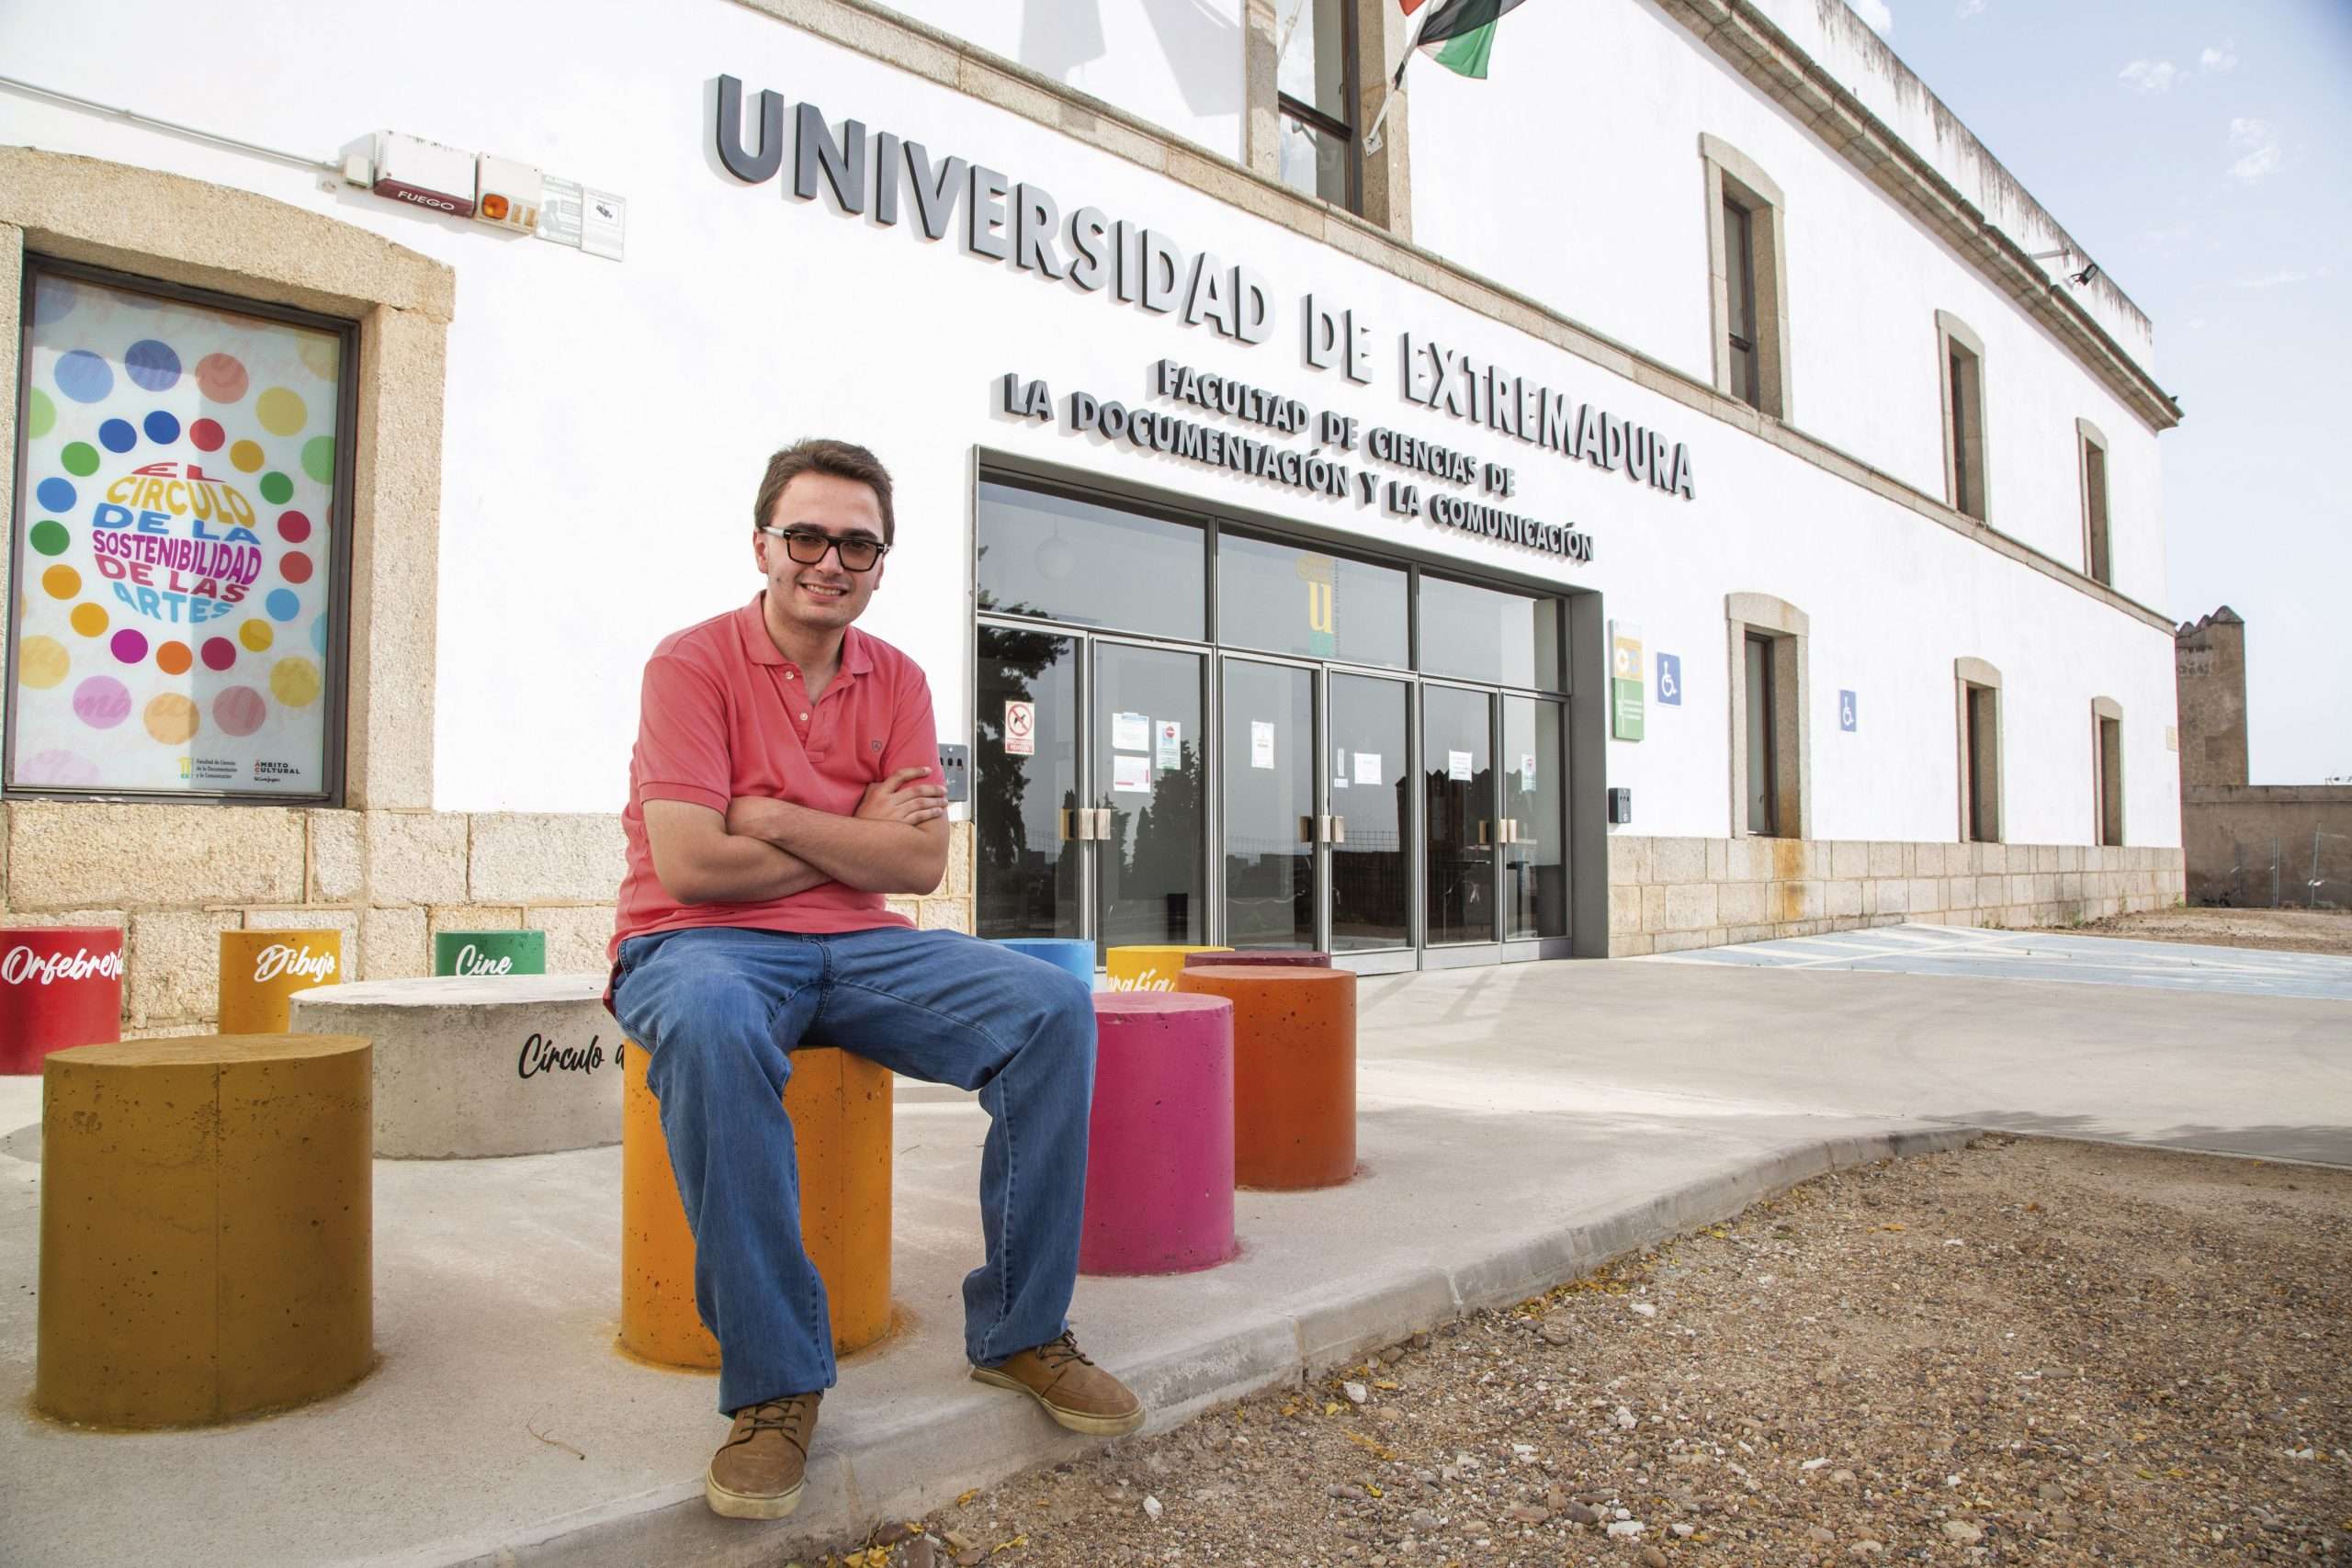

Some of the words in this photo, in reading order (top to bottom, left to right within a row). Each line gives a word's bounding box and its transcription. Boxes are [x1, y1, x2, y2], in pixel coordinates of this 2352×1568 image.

[398, 189, 456, 211] FUEGO
[717, 73, 1275, 345] UNIVERSIDAD
[1306, 293, 1374, 384] DE
[1403, 331, 1696, 500] EXTREMADURA
[1158, 358, 1311, 434] FACULTAD
[1321, 410, 1359, 450] DE
[1369, 426, 1478, 485] CIENCIAS
[1485, 462, 1516, 497] DE
[131, 462, 226, 483] EL
[1003, 372, 1055, 421] LA
[1071, 390, 1351, 497] DOCUMENTACIÓN
[1359, 470, 1380, 504] Y
[1388, 480, 1422, 517] LA
[1430, 492, 1594, 561] COMUNICACIÓN
[92, 502, 171, 535] DE
[192, 519, 262, 546] LA
[106, 476, 256, 528] CIRCULO
[92, 529, 263, 586] SOSTENIBILIDAD
[95, 553, 154, 587] DE
[168, 570, 251, 603] LAS
[112, 581, 235, 624] ARTES
[254, 767, 300, 775] CULTURAL
[254, 943, 336, 983] Dibujo
[455, 944, 514, 976] Cine
[518, 1032, 605, 1079] Círculo
